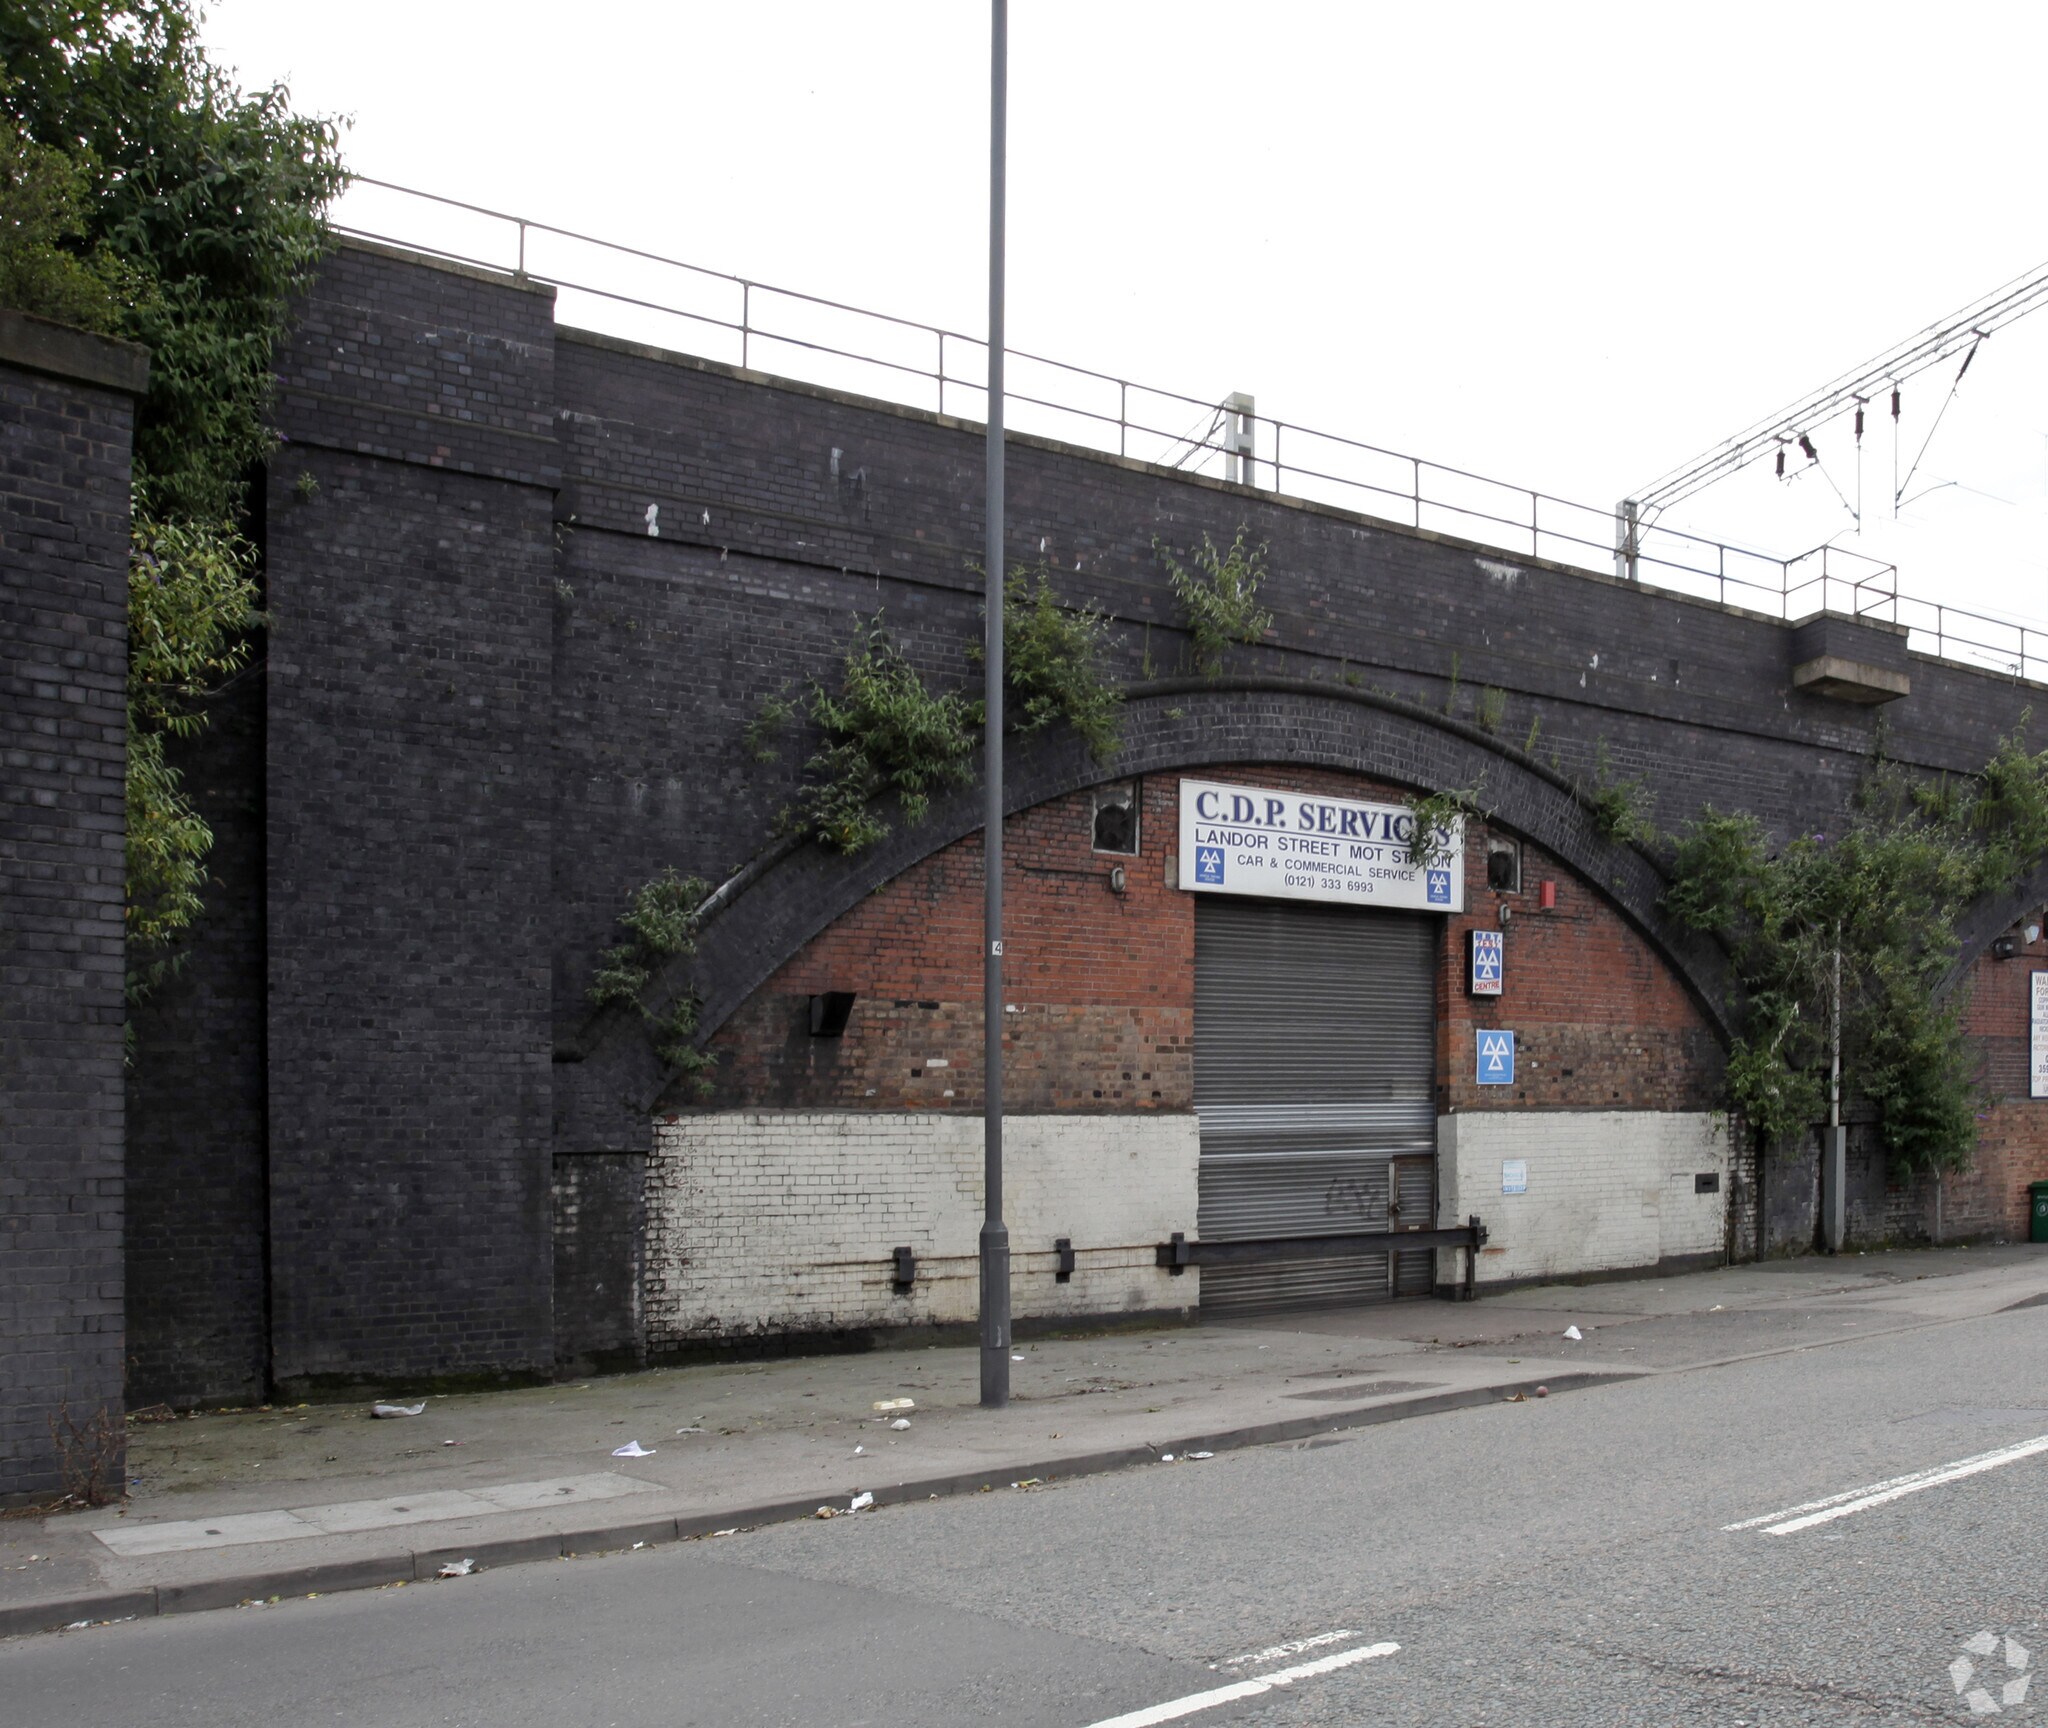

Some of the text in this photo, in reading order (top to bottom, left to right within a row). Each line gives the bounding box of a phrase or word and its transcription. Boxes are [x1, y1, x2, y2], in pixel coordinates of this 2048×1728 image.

[1196, 790, 1450, 847] C.D.P. SERVICS
[1195, 828, 1268, 849] LANDOR
[1278, 836, 1340, 857] STREET
[1350, 845, 1383, 861] MOT
[1237, 854, 1416, 882] CAR & COMMERCIAL SERVICE
[1284, 873, 1374, 893] (0121) 333 6993
[995, 942, 1002, 954] 4
[1475, 981, 1500, 991] CENTRE
